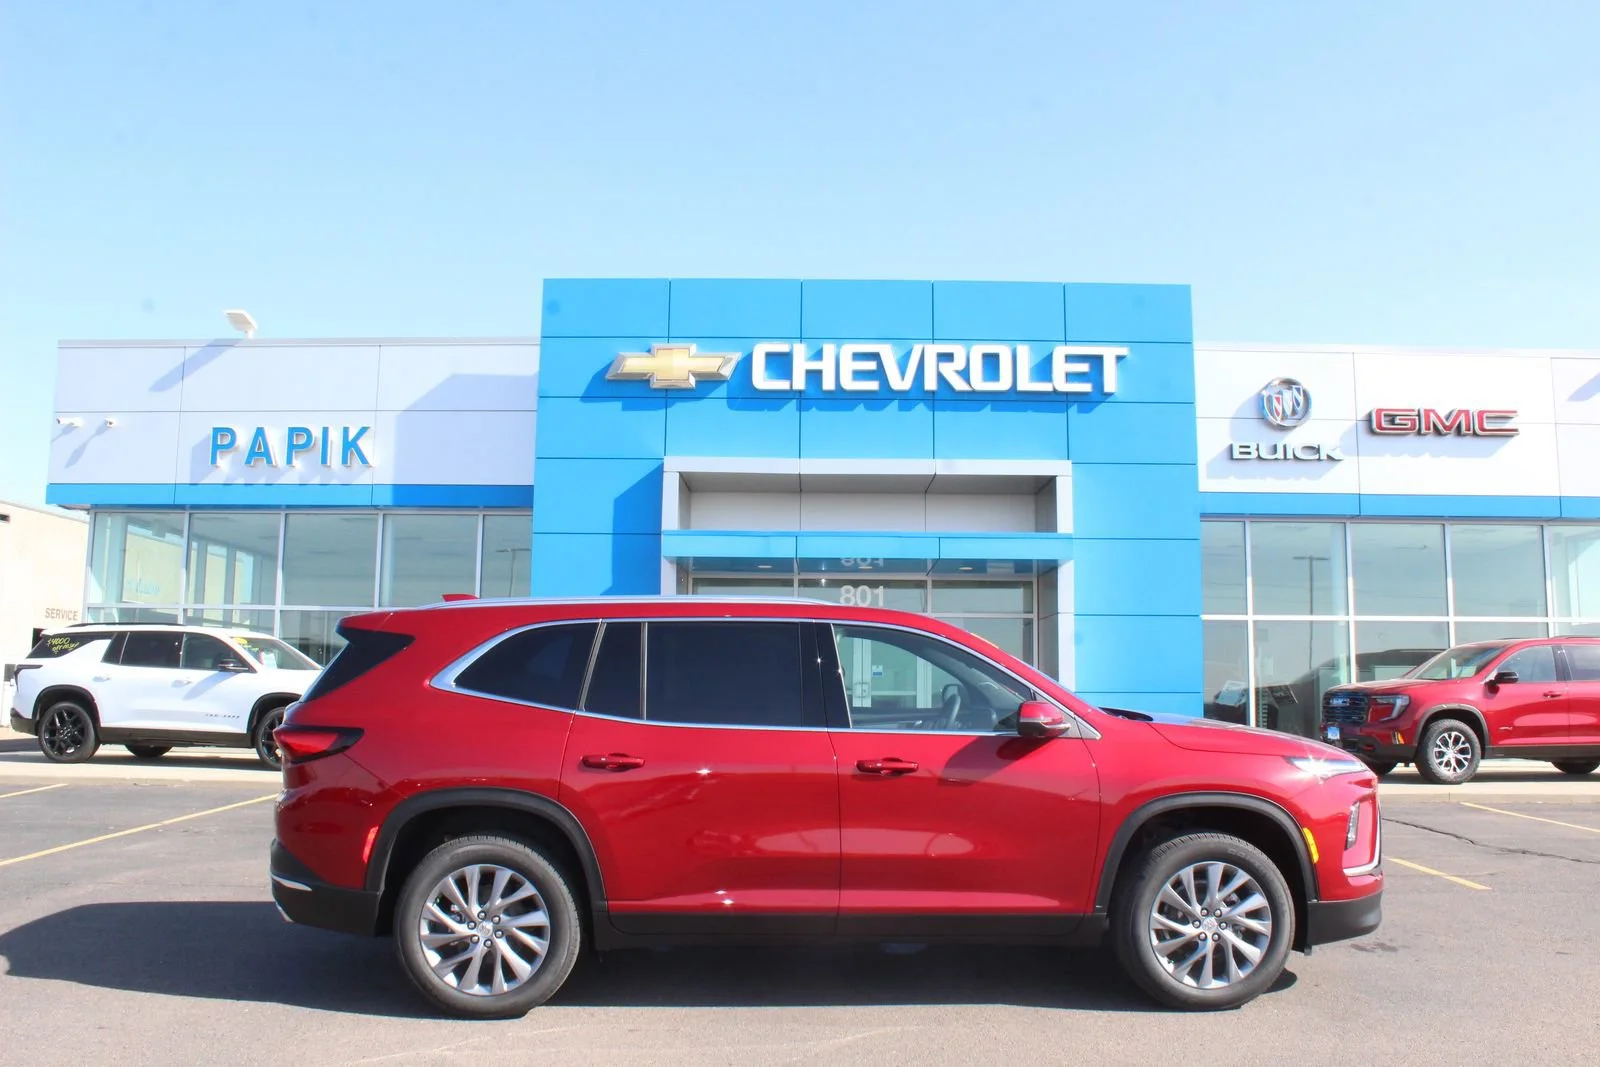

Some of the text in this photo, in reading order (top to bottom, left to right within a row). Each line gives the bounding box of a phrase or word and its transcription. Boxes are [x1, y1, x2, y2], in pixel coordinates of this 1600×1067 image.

[752, 343, 1129, 393] CHEVROLET
[1371, 408, 1520, 436] GMC
[210, 426, 374, 468] PAPIK
[1230, 442, 1343, 462] BUICK
[840, 585, 884, 607] 801
[45, 607, 79, 621] SERVICE
